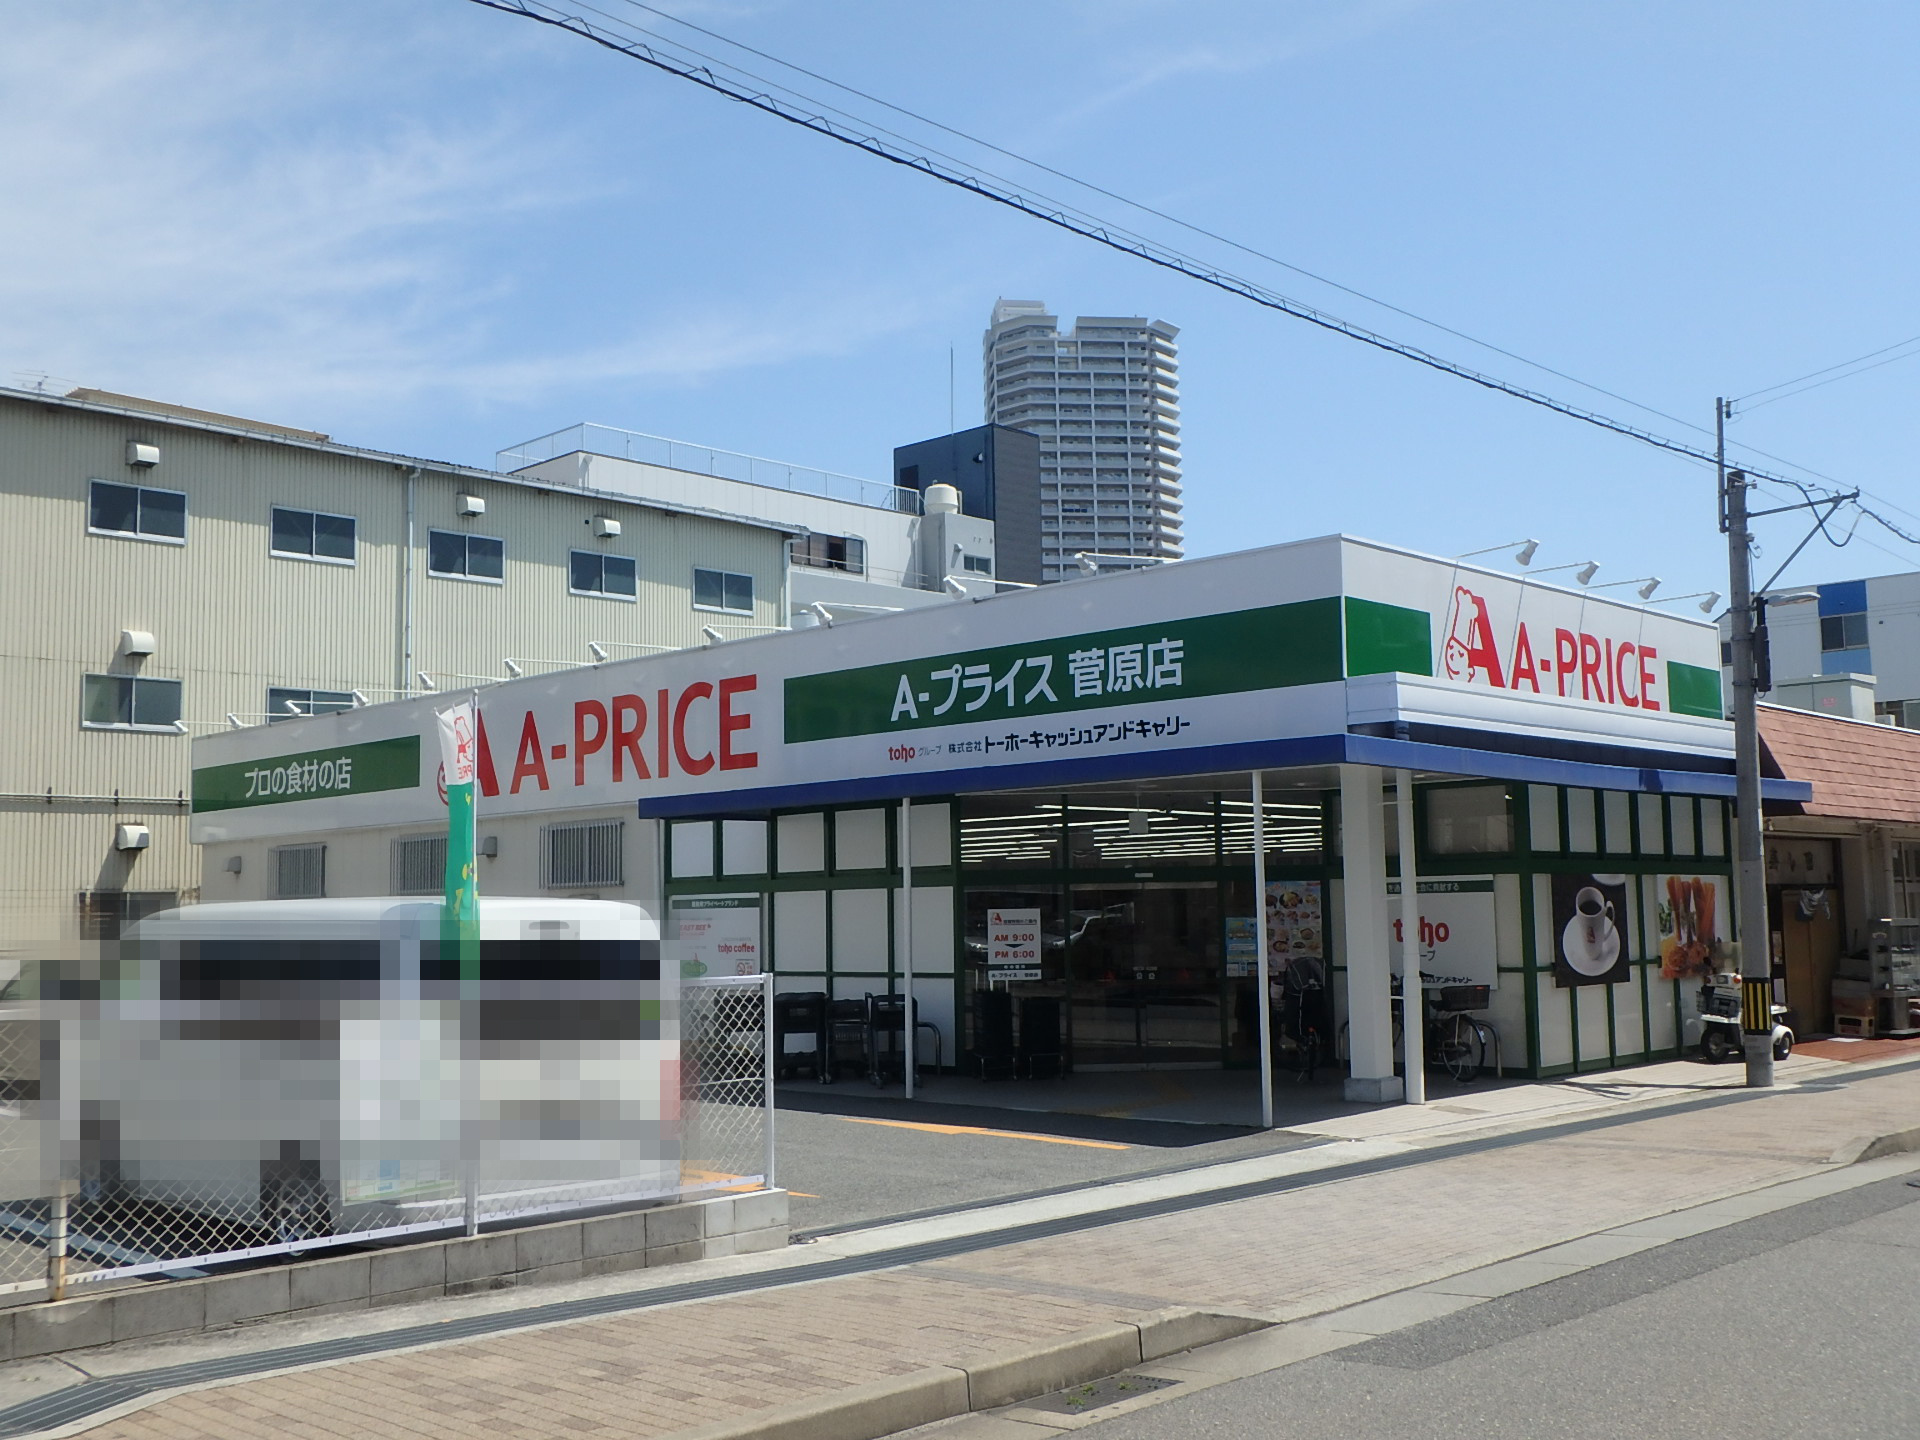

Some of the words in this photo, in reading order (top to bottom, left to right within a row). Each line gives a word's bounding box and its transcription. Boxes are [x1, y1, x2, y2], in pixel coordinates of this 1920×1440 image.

[890, 655, 1058, 722] A-プライス
[1068, 638, 1184, 698] 菅原店
[1511, 621, 1660, 711] A-PRICE
[509, 674, 758, 795] A-PRICE
[888, 745, 916, 762] toho
[984, 716, 1191, 753] トーホーキャッシュアンドキャリー
[244, 756, 352, 798] プロの食材の店
[718, 943, 733, 954] toho
[733, 943, 755, 952] coffee
[994, 934, 1009, 942] AM
[1012, 933, 1035, 942] 9:00
[1392, 915, 1450, 948] tho
[1012, 950, 1035, 958] 6:00
